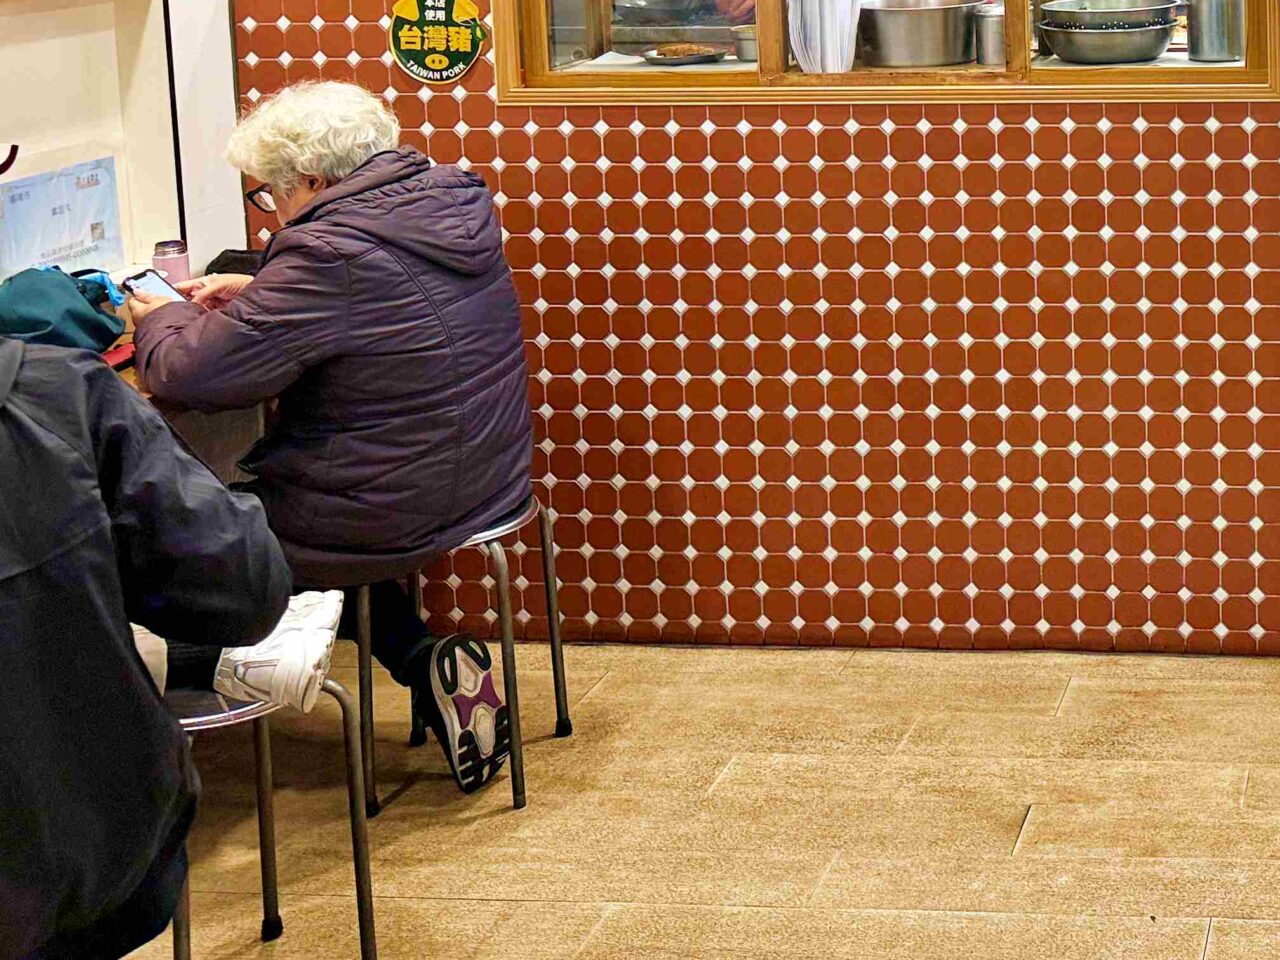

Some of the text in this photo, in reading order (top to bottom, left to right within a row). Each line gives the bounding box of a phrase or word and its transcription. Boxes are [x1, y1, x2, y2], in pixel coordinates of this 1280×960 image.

[424, 10, 446, 21] 使用
[398, 25, 472, 52] 台灣豬
[406, 59, 467, 80] TAIWAN PORK
